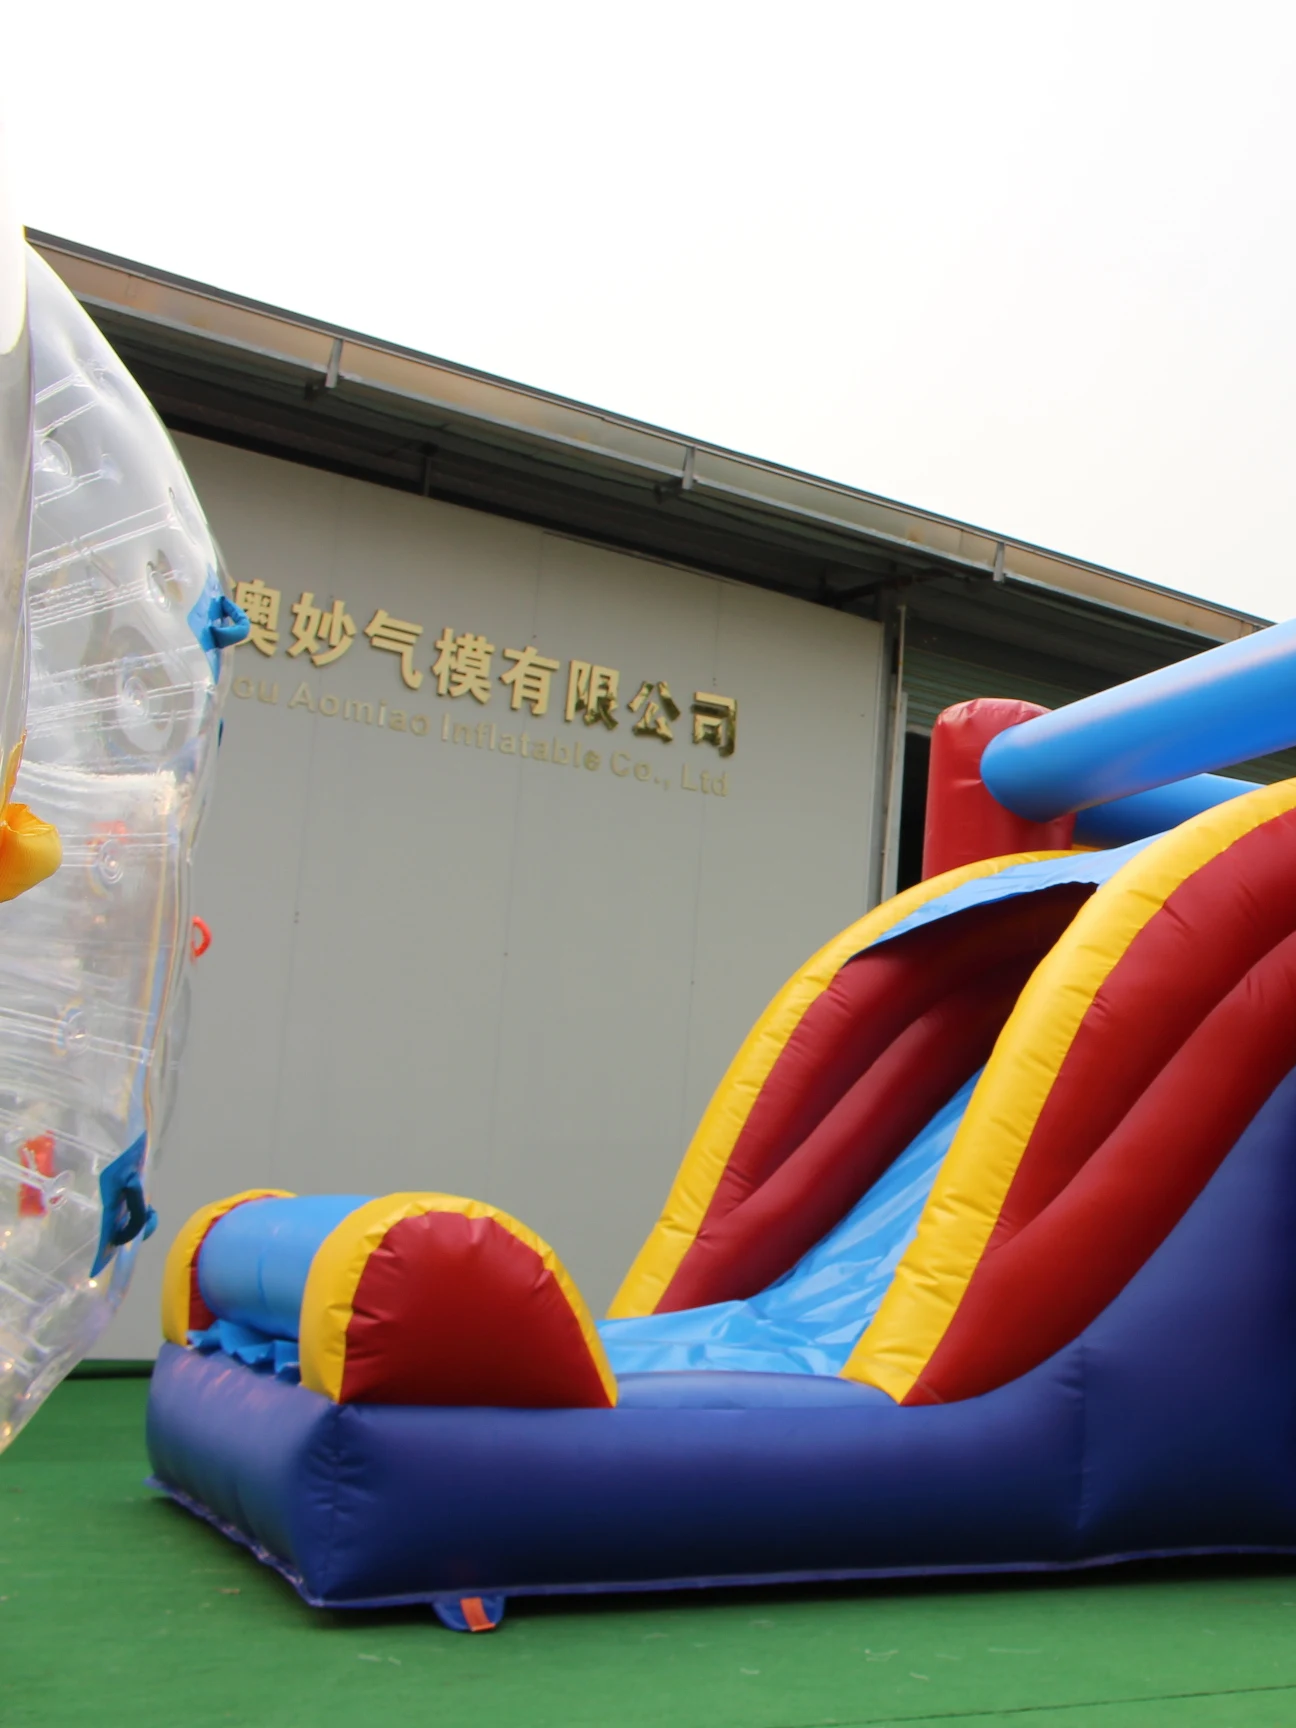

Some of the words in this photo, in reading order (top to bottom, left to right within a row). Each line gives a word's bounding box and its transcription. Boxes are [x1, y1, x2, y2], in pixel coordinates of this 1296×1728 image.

[287, 681, 431, 737] Aomiao
[441, 711, 602, 773] Inflatable
[610, 751, 671, 791] Co.,
[680, 763, 729, 798] Ltd
